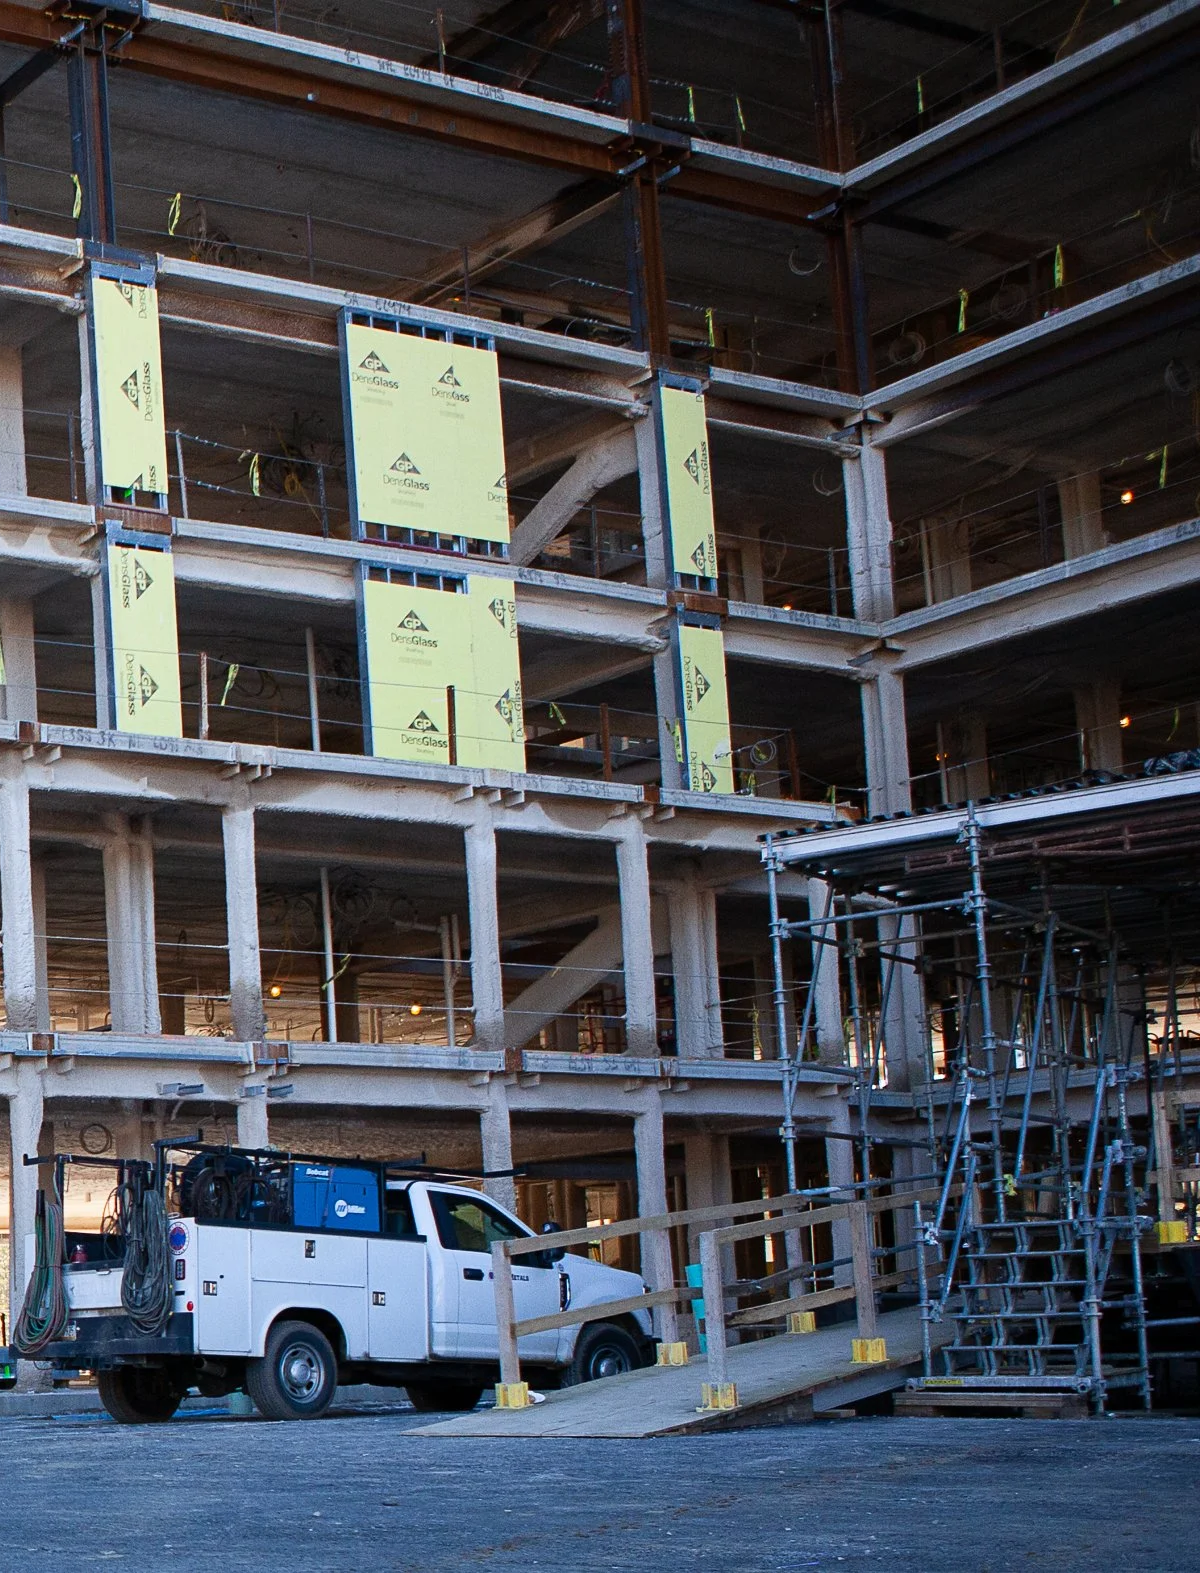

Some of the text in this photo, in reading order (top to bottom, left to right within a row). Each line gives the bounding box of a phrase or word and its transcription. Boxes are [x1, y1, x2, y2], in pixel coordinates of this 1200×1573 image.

[351, 372, 399, 390] DensGlass
[142, 361, 154, 421] DensGlass
[700, 441, 711, 495] DensGlass
[382, 474, 430, 491] DensGlass
[390, 632, 438, 648] DensGlass
[125, 653, 136, 716] DensGlass
[401, 734, 448, 749] DensGlass
[305, 1167, 329, 1177] Bobcat
